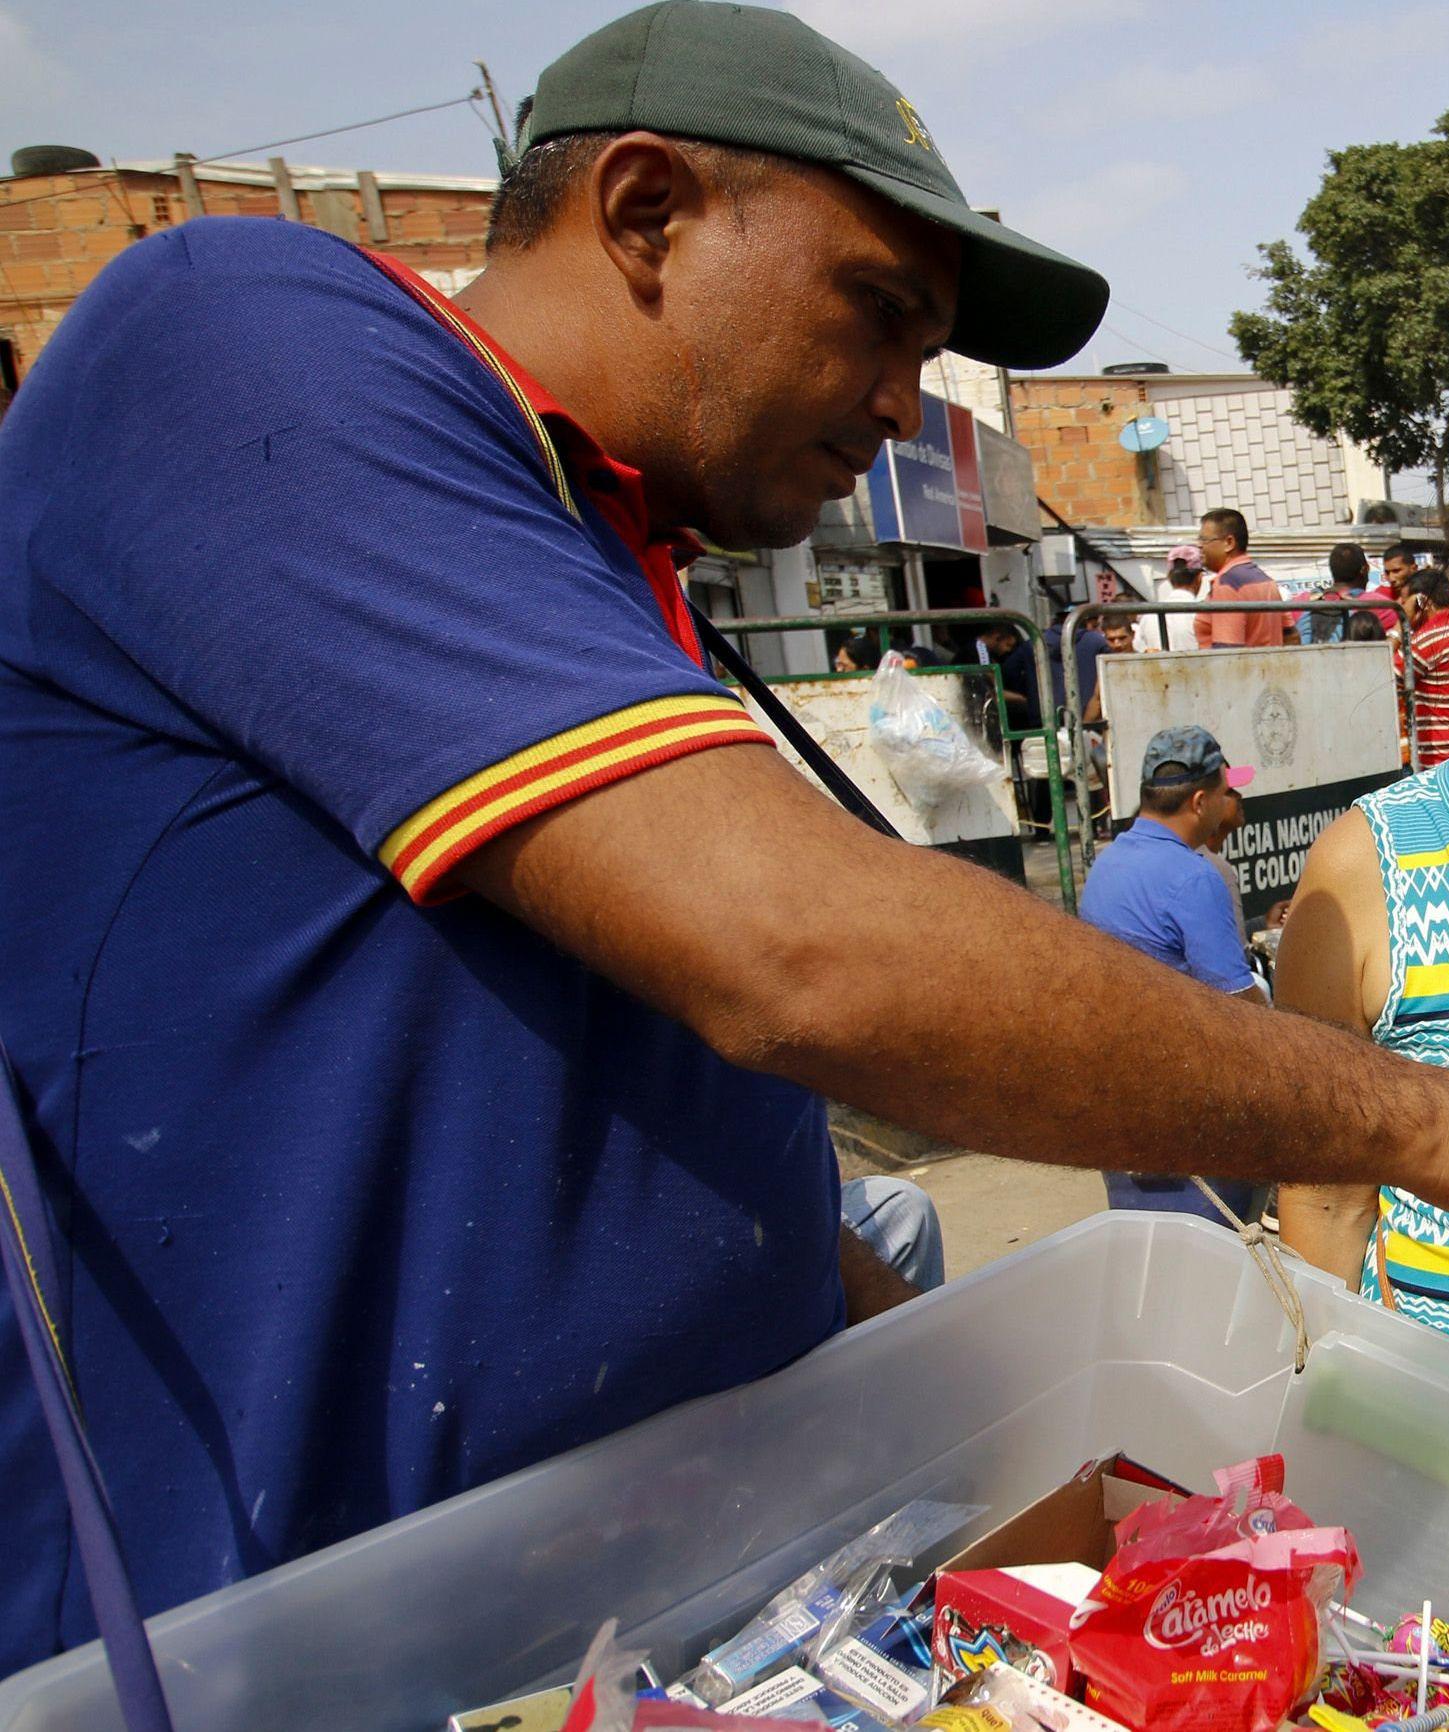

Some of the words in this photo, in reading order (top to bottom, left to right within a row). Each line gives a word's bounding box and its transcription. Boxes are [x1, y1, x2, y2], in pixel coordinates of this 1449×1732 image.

[1218, 821, 1275, 861] OLICIA
[1277, 807, 1346, 850] NACION
[1255, 850, 1309, 890] COLO
[1143, 1573, 1272, 1650] Caramelo
[1171, 1672, 1194, 1684] Soft
[1196, 1670, 1218, 1682] Milk
[1219, 1668, 1268, 1682] Caramel
